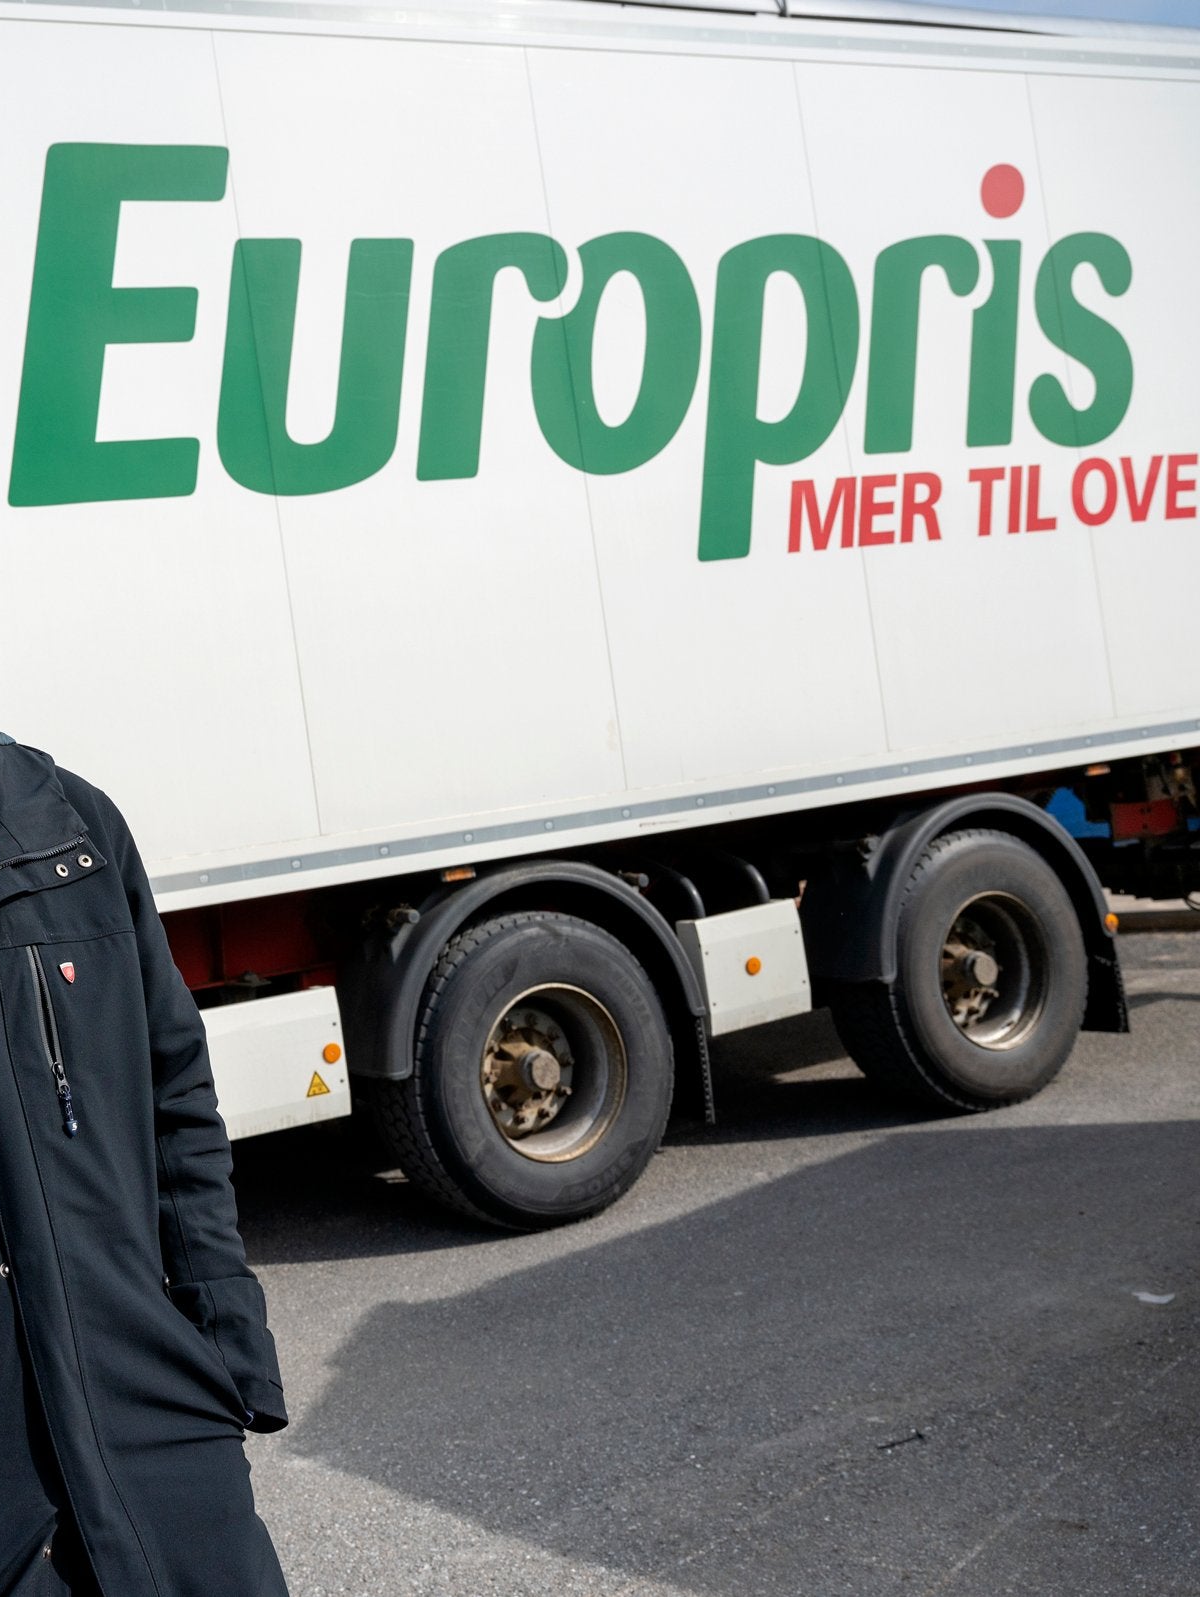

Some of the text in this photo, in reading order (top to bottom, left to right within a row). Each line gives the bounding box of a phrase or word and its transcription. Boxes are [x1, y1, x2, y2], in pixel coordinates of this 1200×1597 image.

[8, 142, 1134, 561] Europris
[787, 453, 1199, 554] MER TIL OVE
